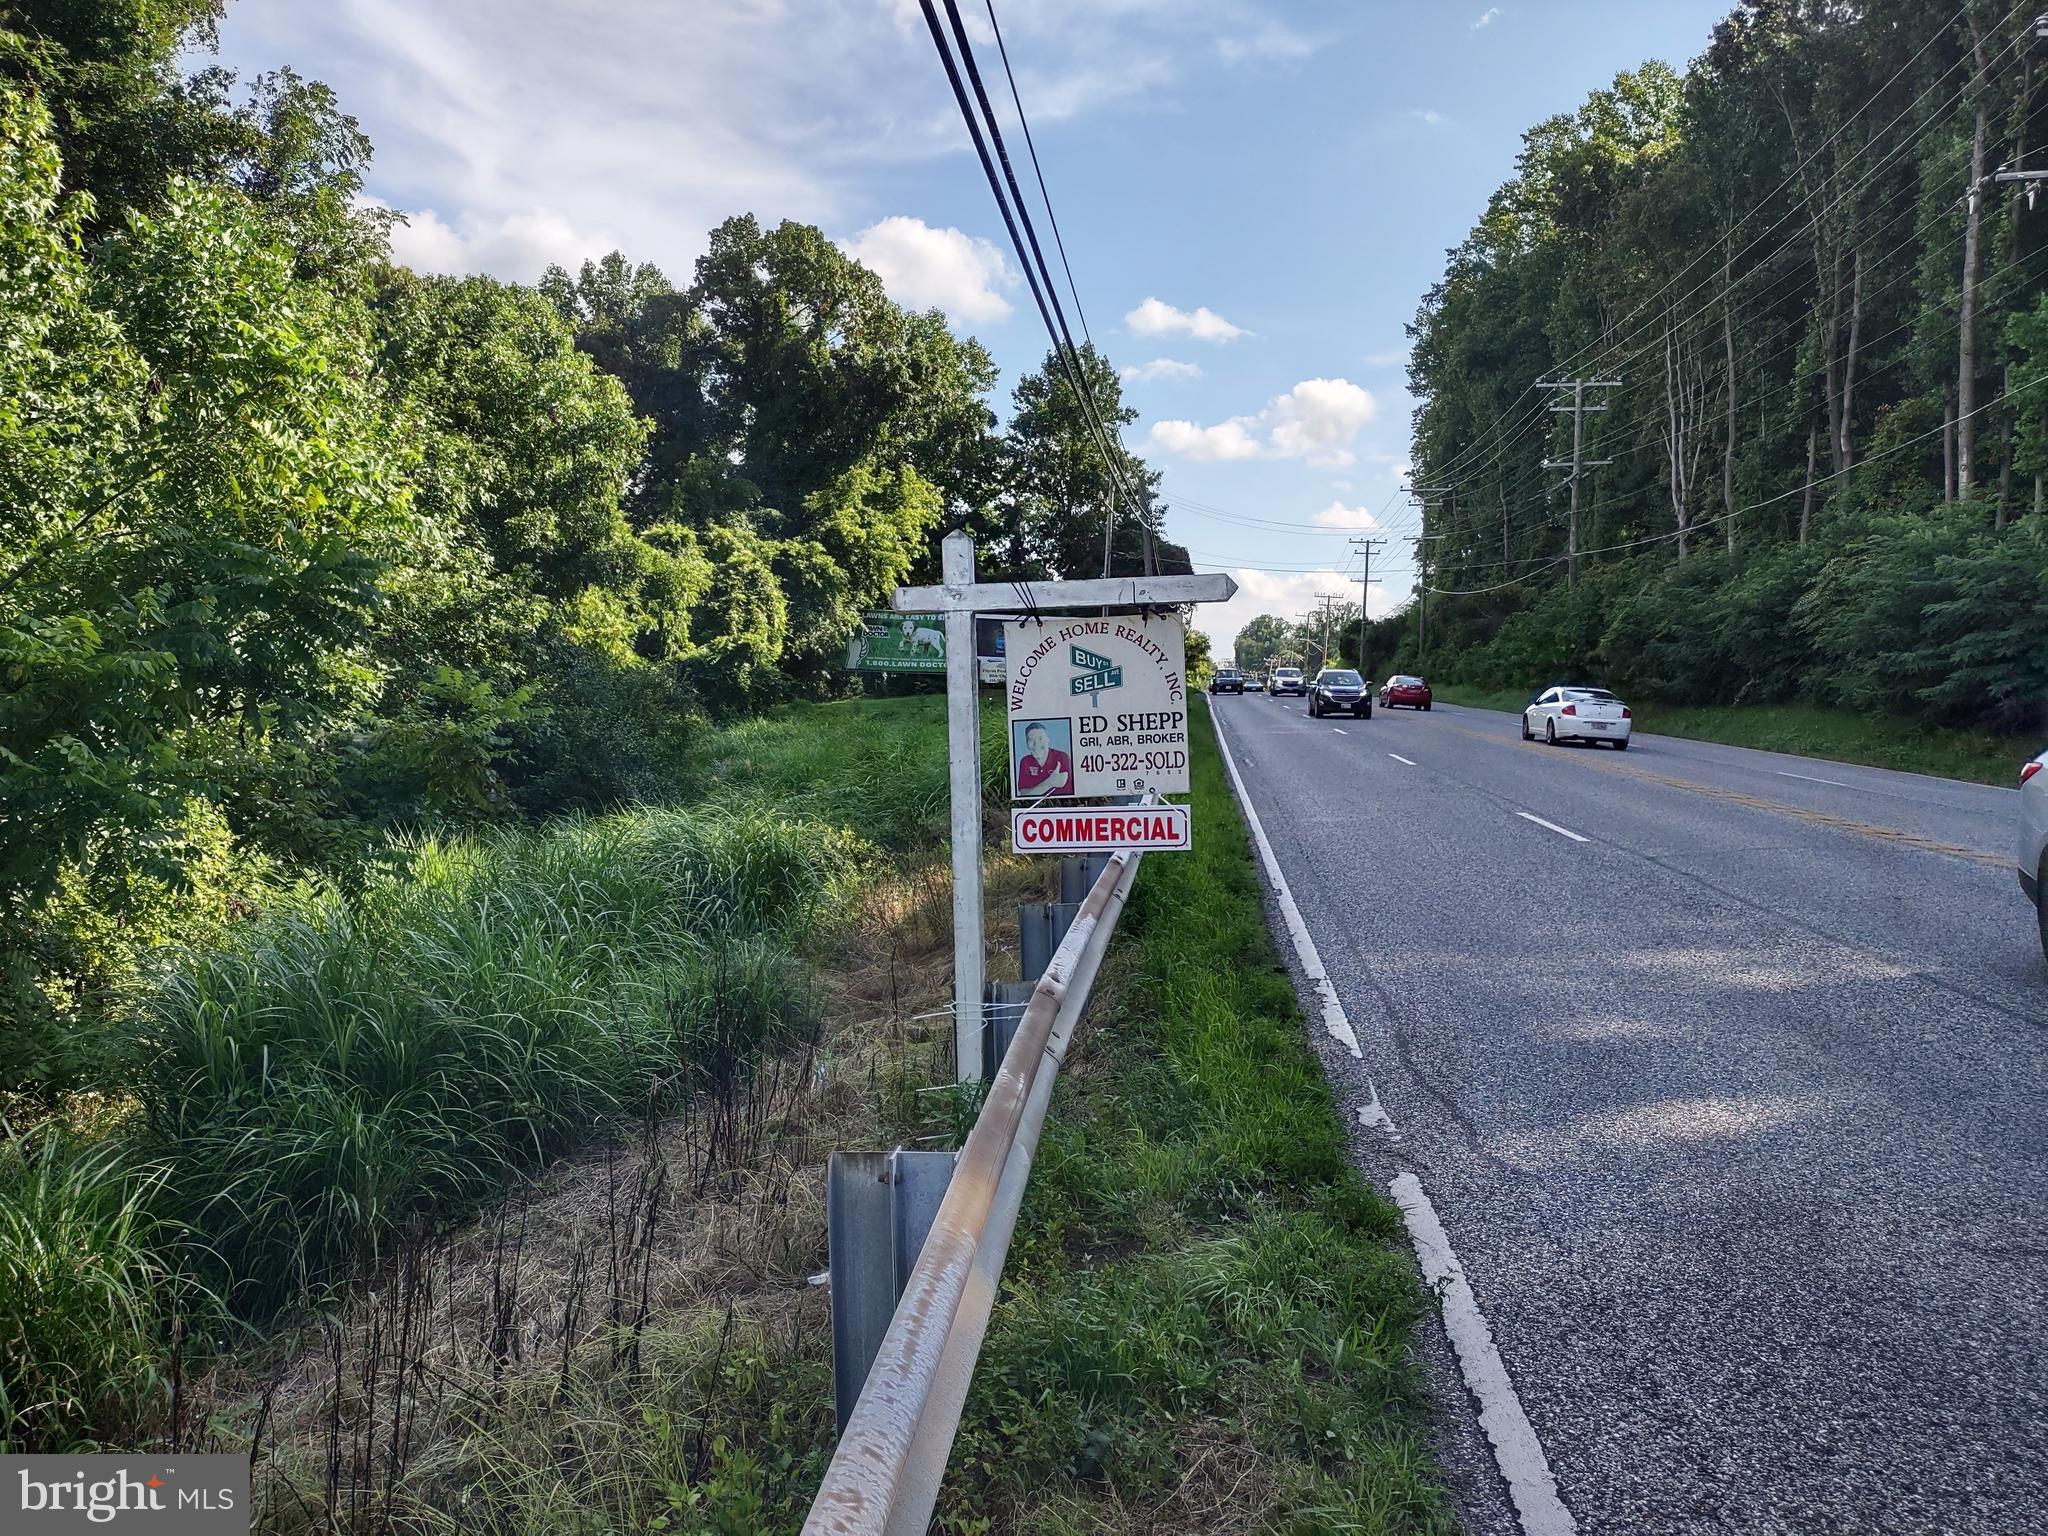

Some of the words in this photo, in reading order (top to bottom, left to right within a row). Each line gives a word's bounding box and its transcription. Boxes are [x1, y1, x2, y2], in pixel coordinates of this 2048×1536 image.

[1011, 636, 1057, 712] WELCOME
[1059, 622, 1110, 642] HOME
[1165, 671, 1183, 705] INC.
[1075, 650, 1103, 669] BUY
[1074, 671, 1116, 693] SELL
[1079, 715, 1108, 734] ED
[1117, 711, 1184, 732] SHEPP
[1080, 737, 1102, 748] GRI,
[1106, 735, 1133, 747] ABR,
[1137, 733, 1185, 745] BROKER
[1080, 751, 1185, 773] 410-322-SOLD
[1022, 816, 1180, 843] COMMERCIAL
